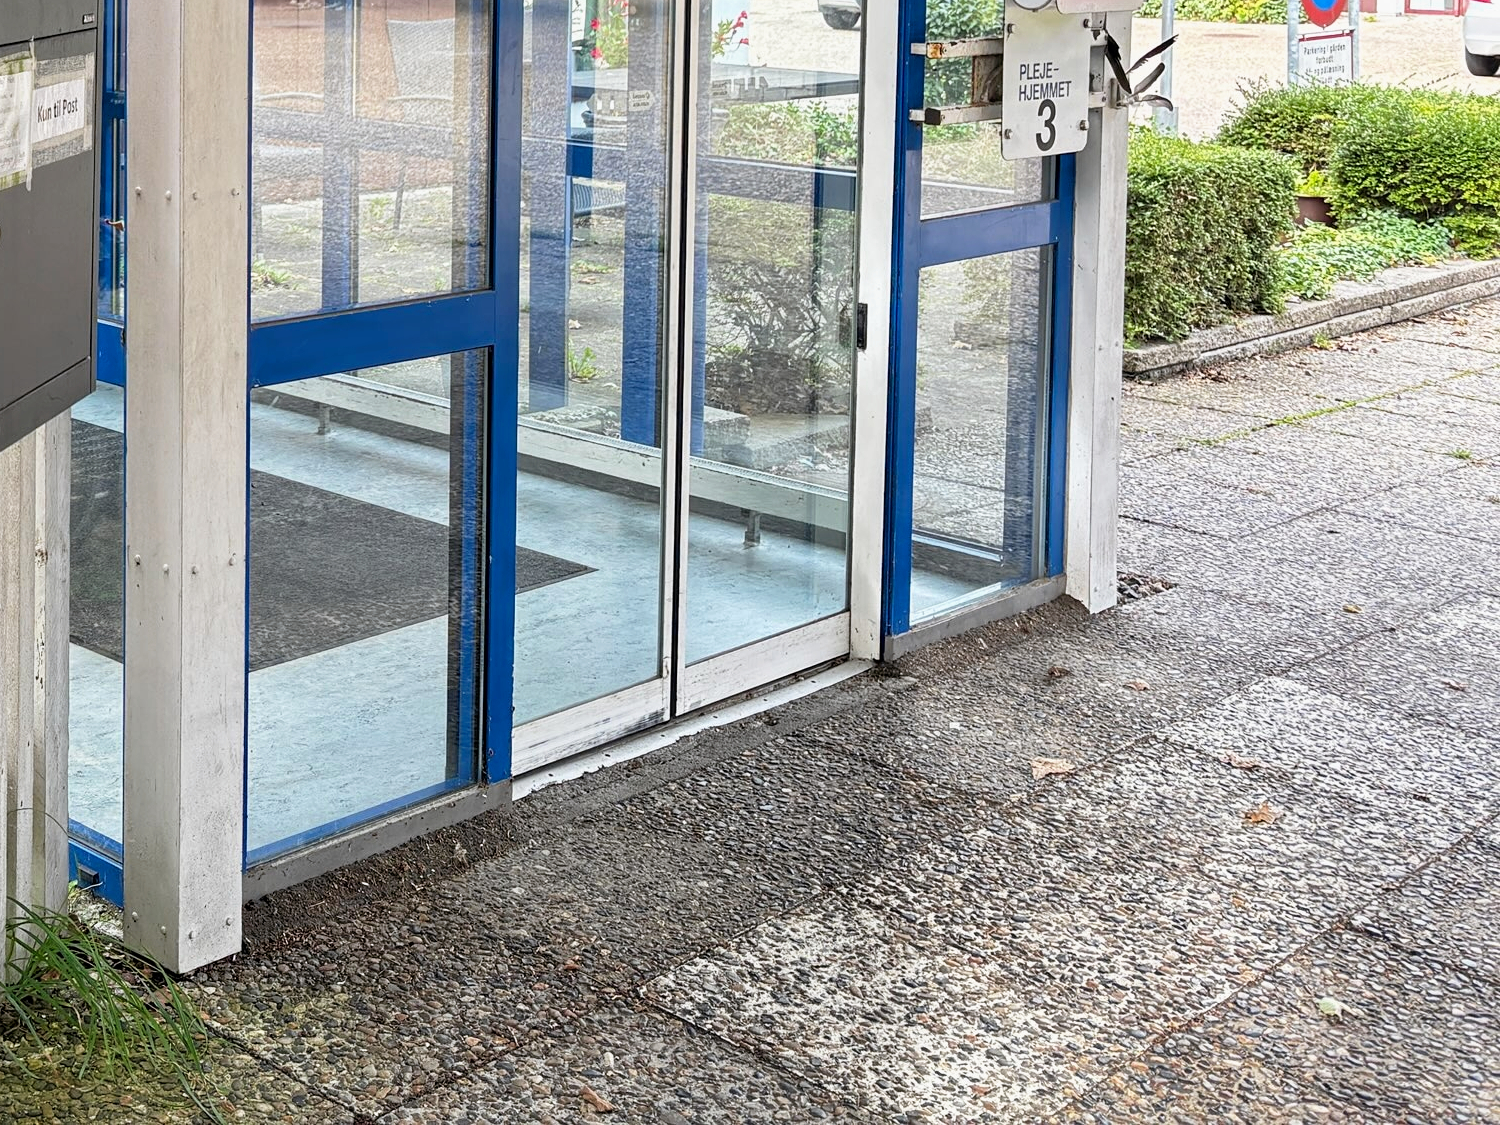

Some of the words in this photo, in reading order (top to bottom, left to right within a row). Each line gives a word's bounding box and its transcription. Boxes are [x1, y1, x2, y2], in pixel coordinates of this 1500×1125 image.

[1019, 62, 1060, 81] PLEJE-
[1018, 80, 1072, 102] HJEMMET
[37, 104, 52, 124] Kun
[53, 98, 61, 118] til
[62, 96, 78, 116] Post
[1035, 98, 1056, 152] 3
